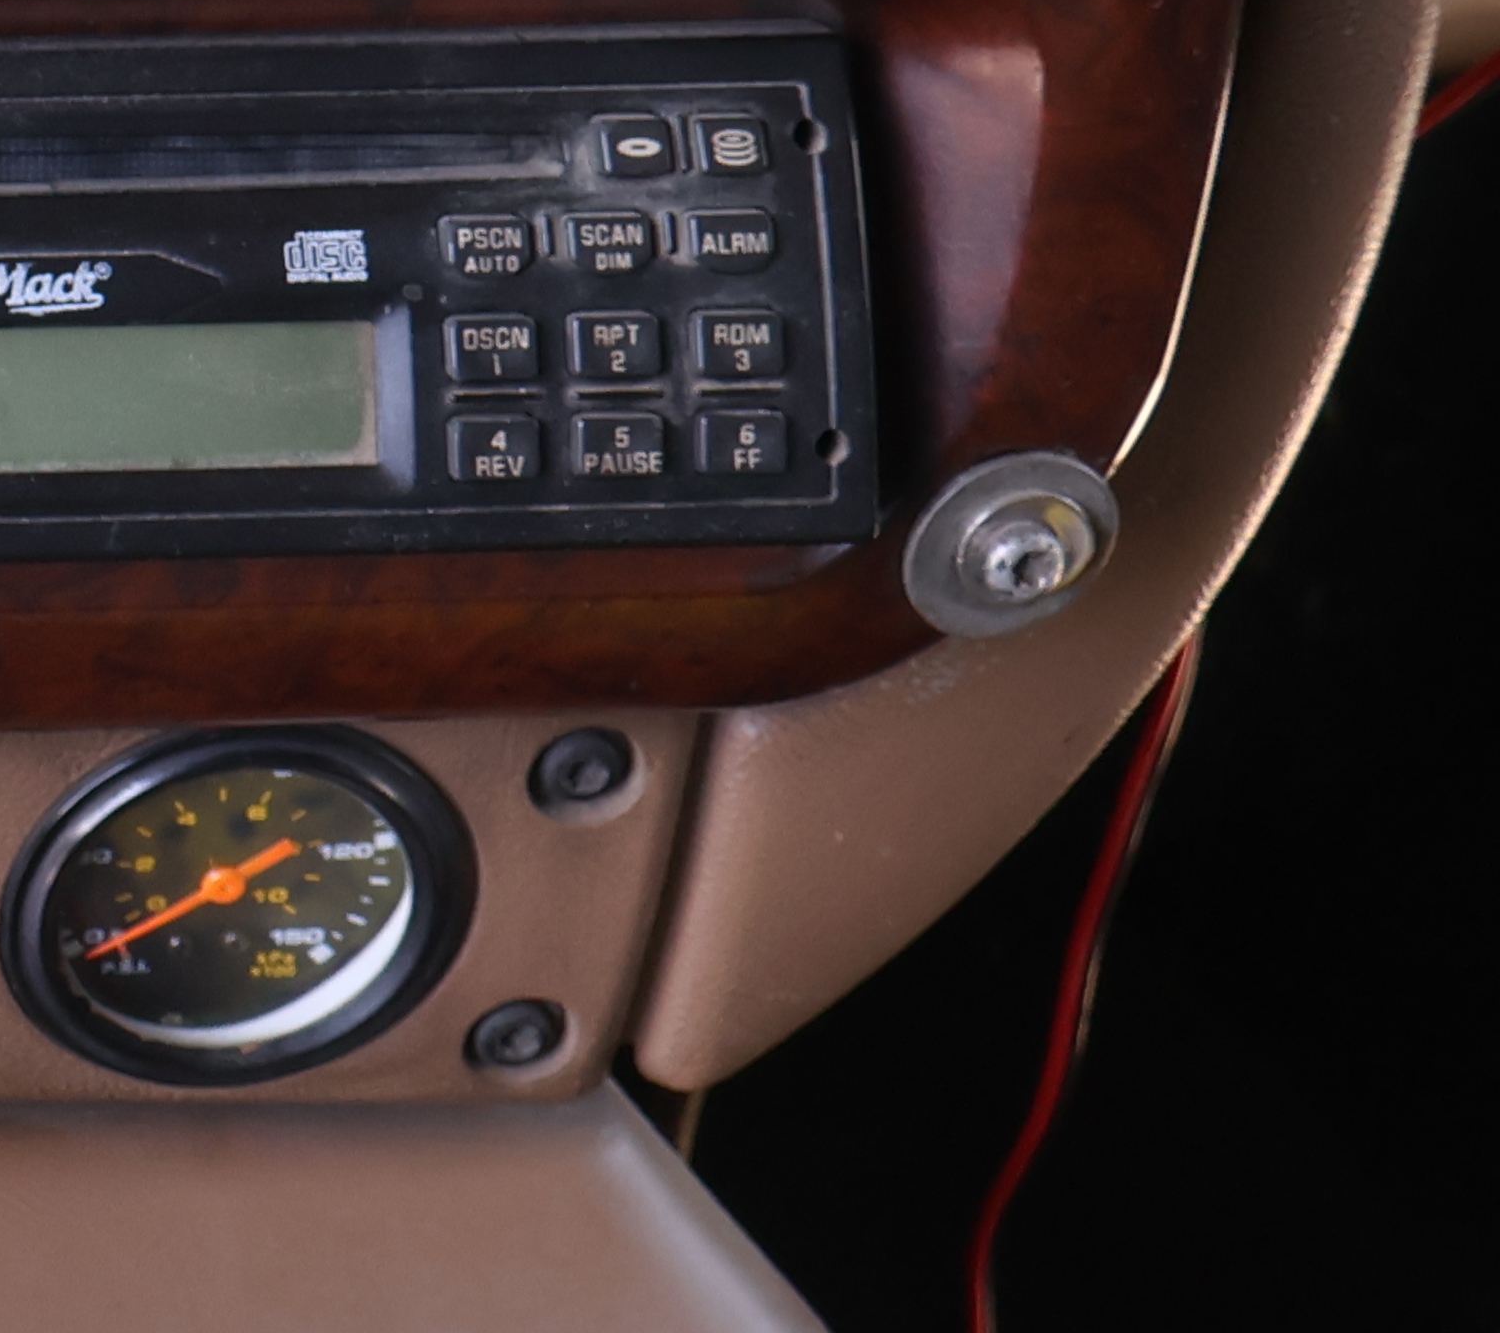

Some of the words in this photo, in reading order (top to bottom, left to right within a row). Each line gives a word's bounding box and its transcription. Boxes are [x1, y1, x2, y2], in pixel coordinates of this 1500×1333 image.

[457, 227, 523, 251] PSCN
[579, 223, 644, 247] SCAN
[701, 232, 770, 255] ALRM
[463, 254, 521, 274] AUTO
[594, 251, 634, 271] DIM
[462, 326, 531, 351] DSCN
[593, 324, 640, 347] RPT
[713, 322, 770, 345] RDM
[491, 352, 502, 376] 1
[609, 349, 628, 373] 2
[733, 348, 751, 372] 3
[490, 429, 508, 452] 4
[614, 426, 631, 449] 5
[738, 422, 756, 446] 6
[474, 454, 526, 479] REV
[583, 450, 665, 475] PAUSE
[732, 447, 763, 472] FF
